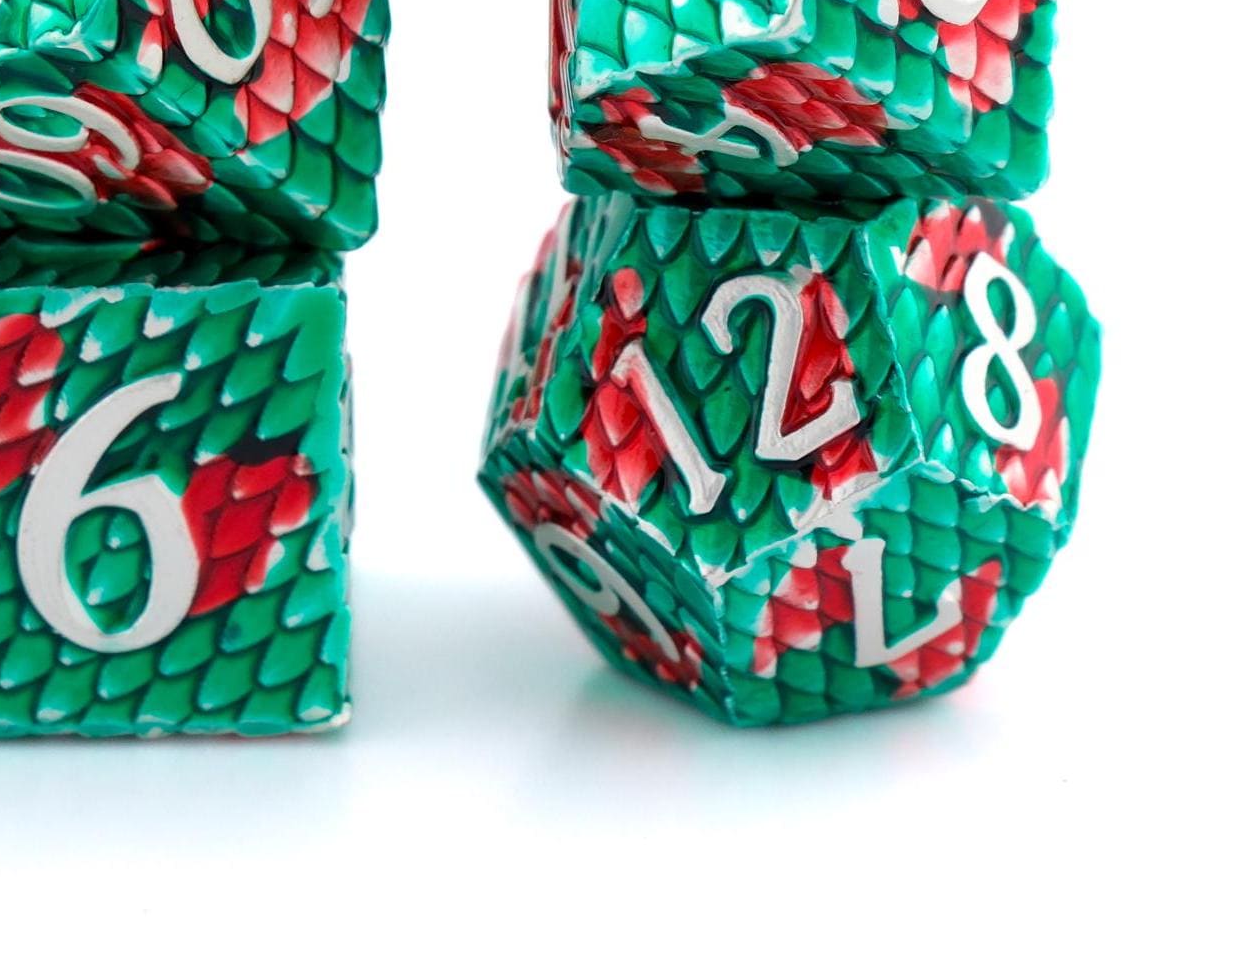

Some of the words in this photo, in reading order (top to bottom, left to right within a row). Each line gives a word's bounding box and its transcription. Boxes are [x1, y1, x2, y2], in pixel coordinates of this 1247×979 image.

[611, 274, 861, 514] 12
[961, 252, 1042, 451] 8
[17, 372, 201, 653] 6
[844, 539, 963, 669] 7
